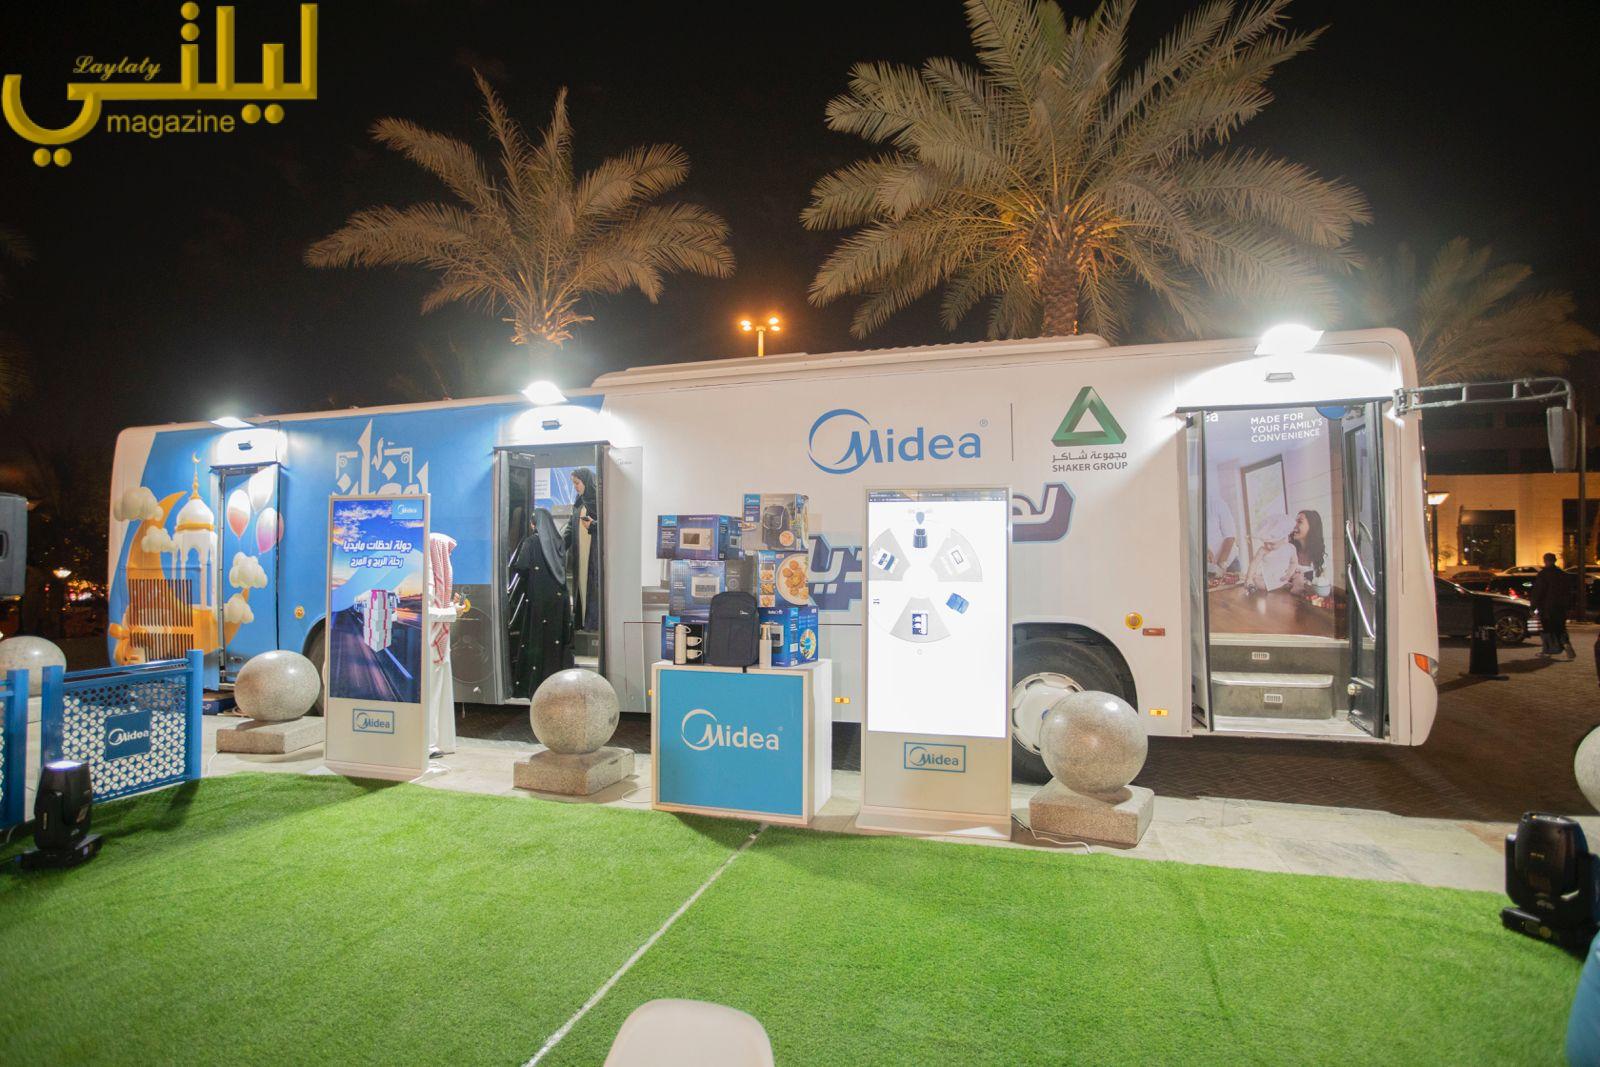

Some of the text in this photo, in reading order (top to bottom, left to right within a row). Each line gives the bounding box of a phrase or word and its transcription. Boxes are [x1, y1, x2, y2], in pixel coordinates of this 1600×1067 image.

[1250, 412, 1304, 425] MADE FOR
[1251, 418, 1323, 434] YOUR FAMILY'S
[808, 408, 981, 475] Midea
[1251, 428, 1321, 443] CONVENIENCE
[1052, 450, 1127, 463] مجموعة شاكر
[1052, 461, 1128, 472] SHAKER GROUP
[356, 712, 391, 729] Midea
[108, 728, 149, 746] Midea
[681, 708, 780, 751] Midea
[909, 746, 959, 767] Midea
